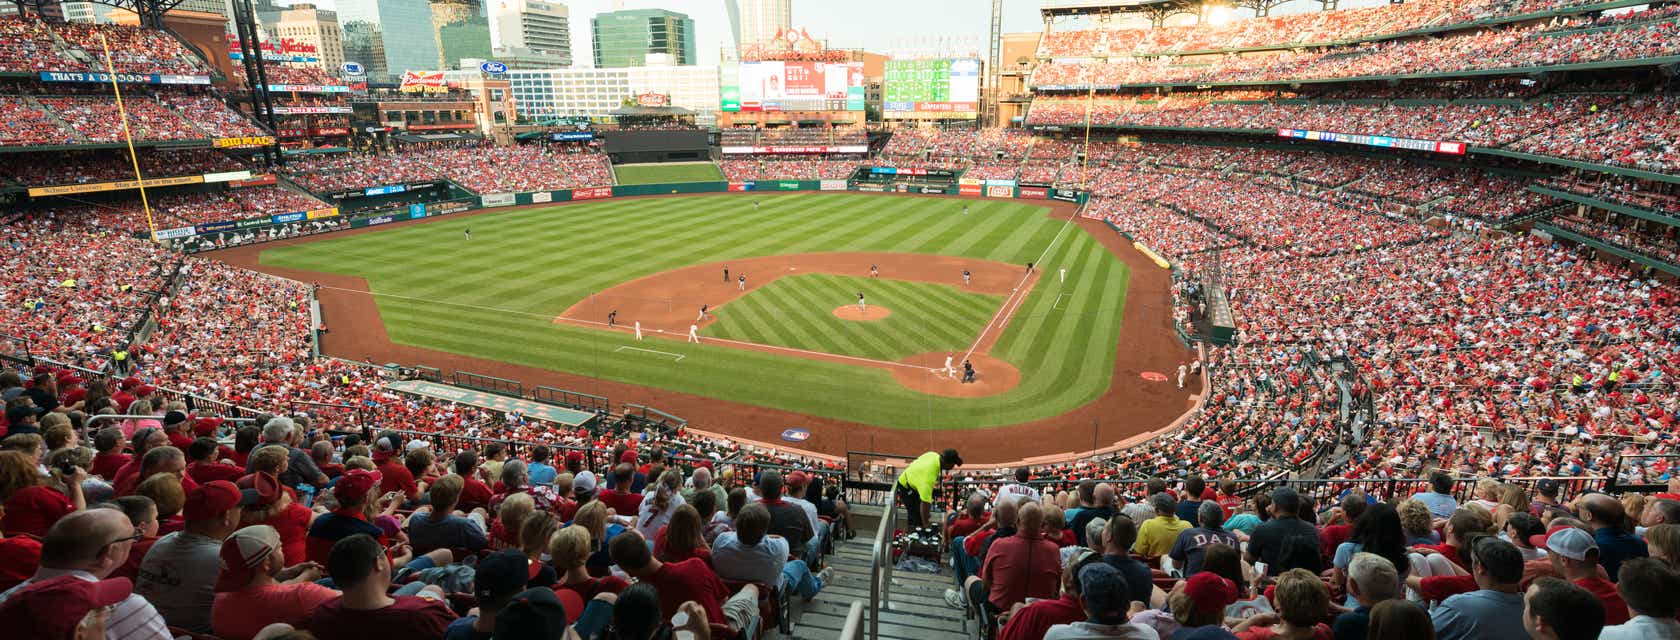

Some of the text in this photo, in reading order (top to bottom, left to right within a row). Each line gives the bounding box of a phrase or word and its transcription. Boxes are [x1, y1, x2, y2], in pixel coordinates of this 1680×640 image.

[274, 38, 316, 54] Nation
[486, 63, 503, 72] Ford
[51, 73, 83, 81] THAT'S
[402, 85, 448, 94] BREW HOUSE
[221, 136, 269, 148] BIG MAC
[1008, 486, 1034, 498] MOLINA
[643, 508, 658, 528] 7
